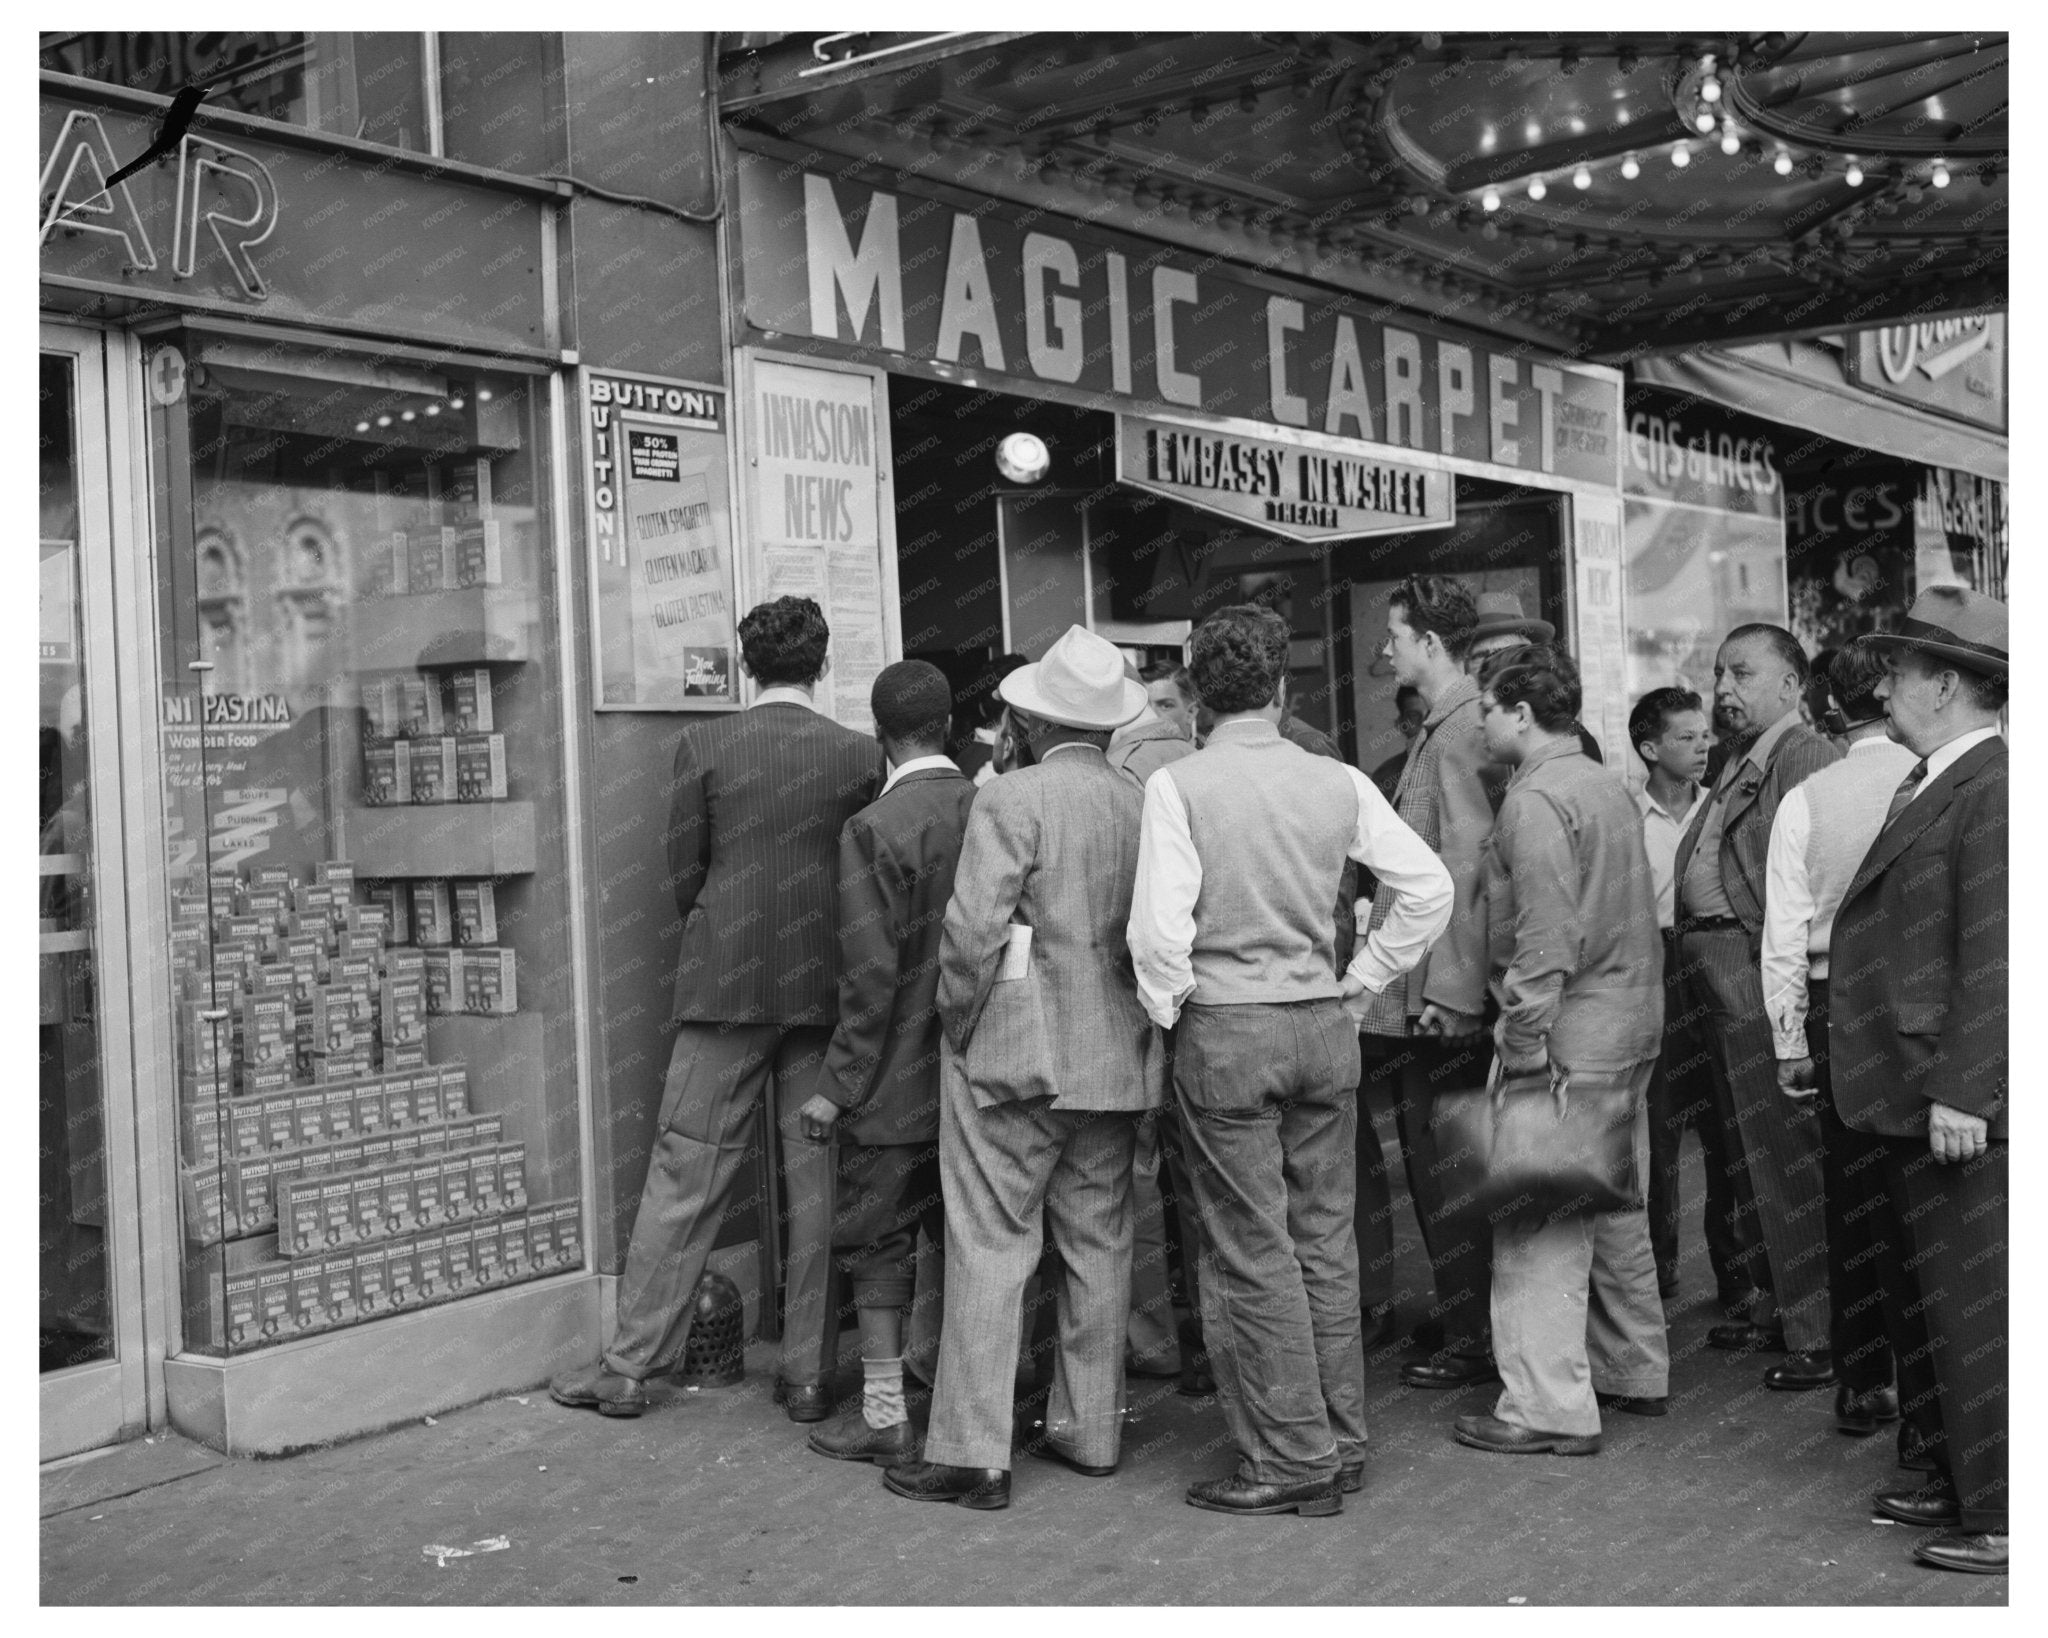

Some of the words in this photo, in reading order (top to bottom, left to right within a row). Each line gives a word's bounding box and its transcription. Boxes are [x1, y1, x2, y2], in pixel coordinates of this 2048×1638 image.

[803, 172, 1202, 407] MAGIC
[1267, 293, 1563, 474] CARPET
[590, 379, 716, 416] BUITONI
[762, 392, 870, 467] INVASION
[643, 436, 668, 449] 50%
[1147, 429, 1284, 497] EMBASSY
[784, 473, 853, 543] NEWS
[636, 510, 670, 540] GLUTEN
[645, 556, 679, 585] GLUTEN
[203, 695, 290, 723] PASTINA
[413, 1076, 439, 1086] BUITONI
[441, 1072, 466, 1082] BUITONI
[355, 1085, 381, 1096] BUITONI
[385, 1080, 411, 1091] BUITONI
[296, 1095, 323, 1106] BUITONI
[326, 1090, 353, 1101] BUITONI
[233, 1105, 262, 1116] BUITONI
[265, 1100, 293, 1111] BUITONI
[471, 1154, 497, 1165] BUITONI
[500, 1150, 524, 1161] BUITONI
[443, 1160, 469, 1171] BUITONI
[413, 1166, 440, 1177] BUITONI
[383, 1172, 411, 1183] BUITONI
[354, 1178, 381, 1189] BUITONI
[323, 1184, 351, 1195] BUITONI
[291, 1190, 320, 1201] BUITONI
[555, 1207, 578, 1218] BUITONI
[529, 1213, 553, 1224] BUITONI
[501, 1219, 526, 1230] BUITONI
[474, 1225, 499, 1237] BUITONI
[445, 1231, 471, 1243] BUITONI
[416, 1238, 442, 1249] BUITONI
[387, 1245, 415, 1256] BUITONI
[356, 1252, 385, 1263] BUITONI
[325, 1258, 353, 1270] BUITONI
[293, 1265, 322, 1277] BUITONI
[260, 1272, 290, 1284] BUITONI
[226, 1280, 256, 1291] BUITONI
